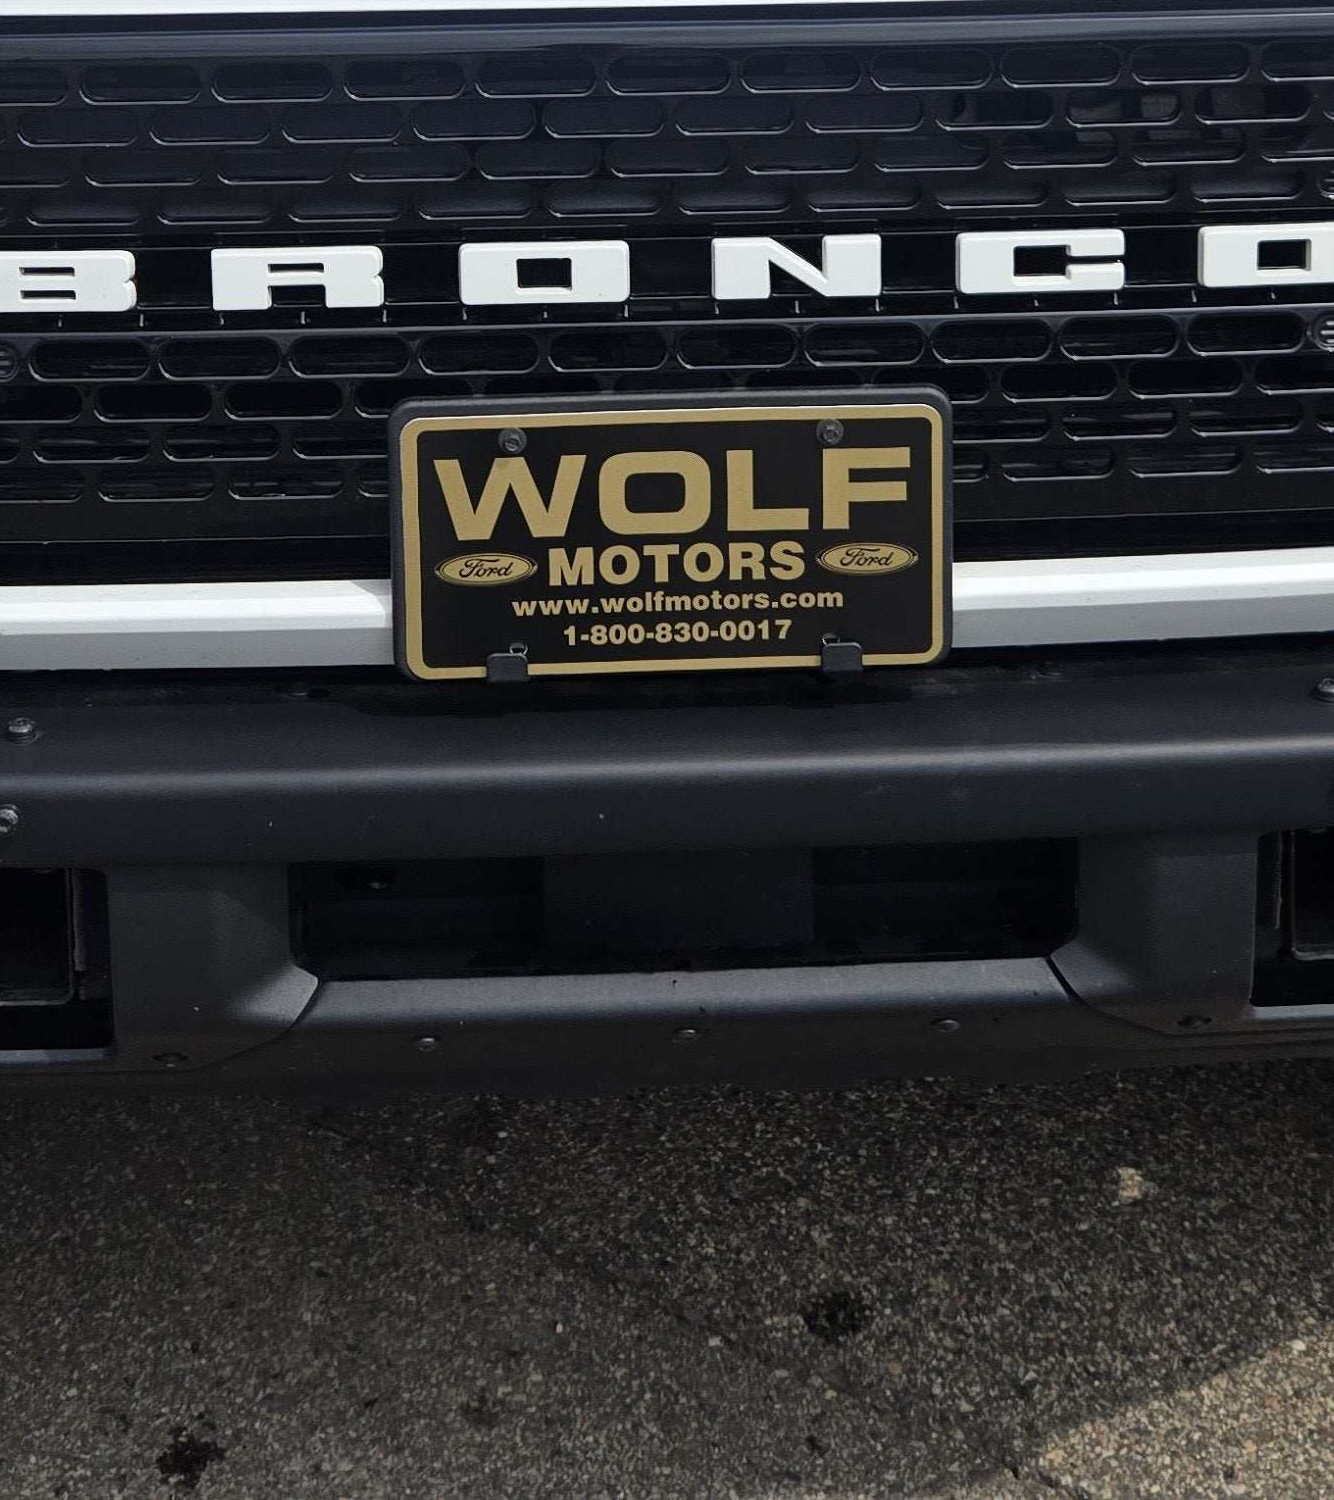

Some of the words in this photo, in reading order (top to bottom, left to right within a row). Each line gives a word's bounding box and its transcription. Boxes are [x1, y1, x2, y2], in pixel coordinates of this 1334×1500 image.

[432, 446, 911, 542] WOLF
[459, 557, 513, 579] Ford
[548, 540, 806, 587] MOTORS
[839, 546, 894, 568] Ford
[511, 590, 844, 617] www.wolfmotors.com
[563, 619, 792, 647] 1-800-830-0017
